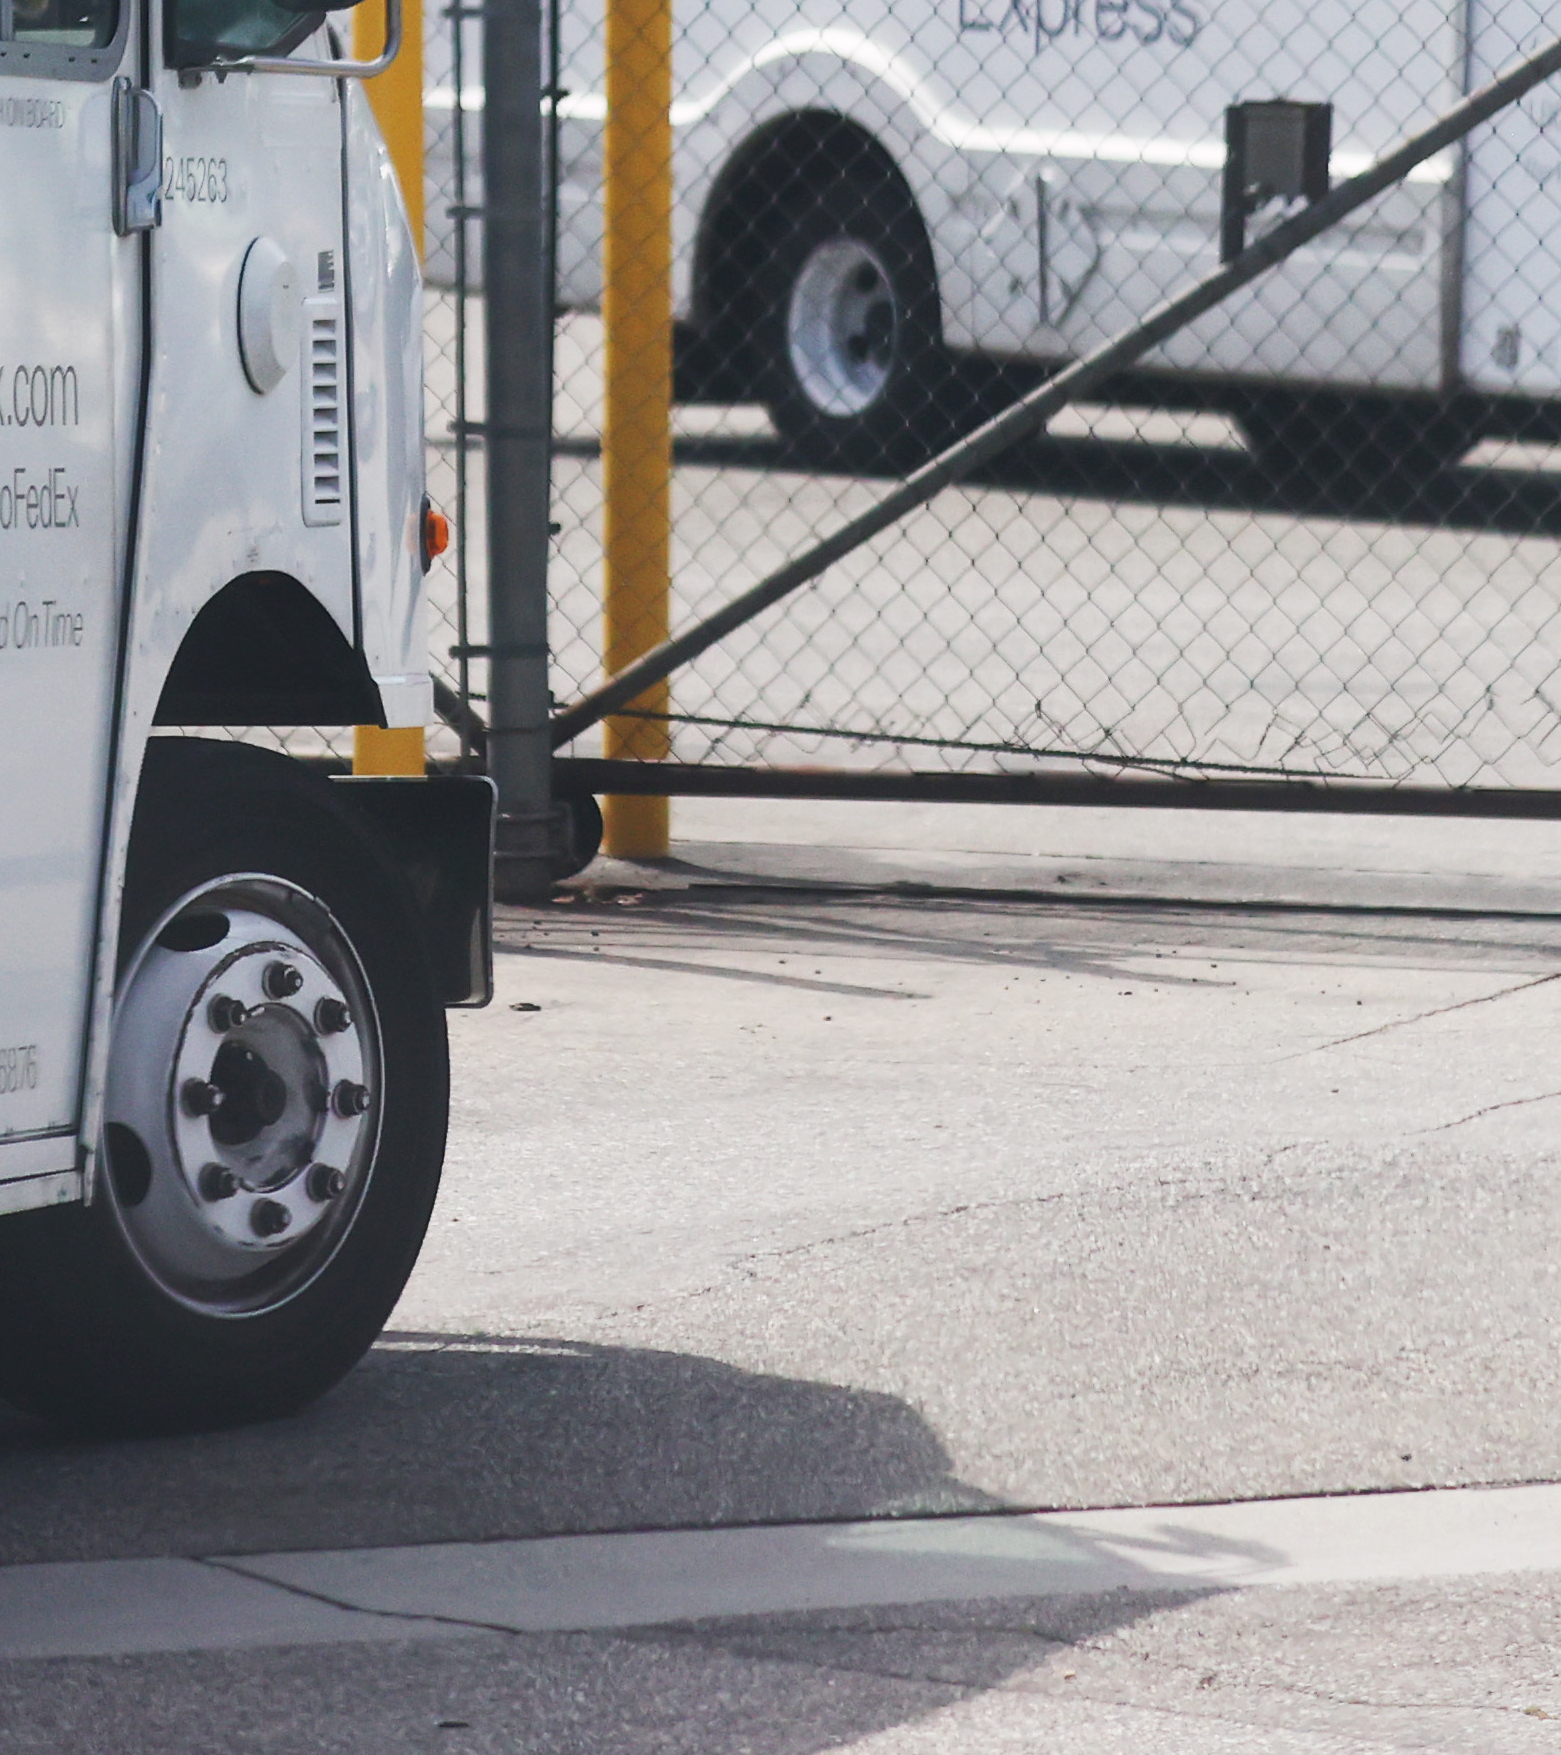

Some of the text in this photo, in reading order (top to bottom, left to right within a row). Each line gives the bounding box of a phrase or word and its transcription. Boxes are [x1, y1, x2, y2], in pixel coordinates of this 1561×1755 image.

[164, 156, 228, 203] 245263
[13, 600, 39, 649] On
[41, 599, 83, 647] Time
